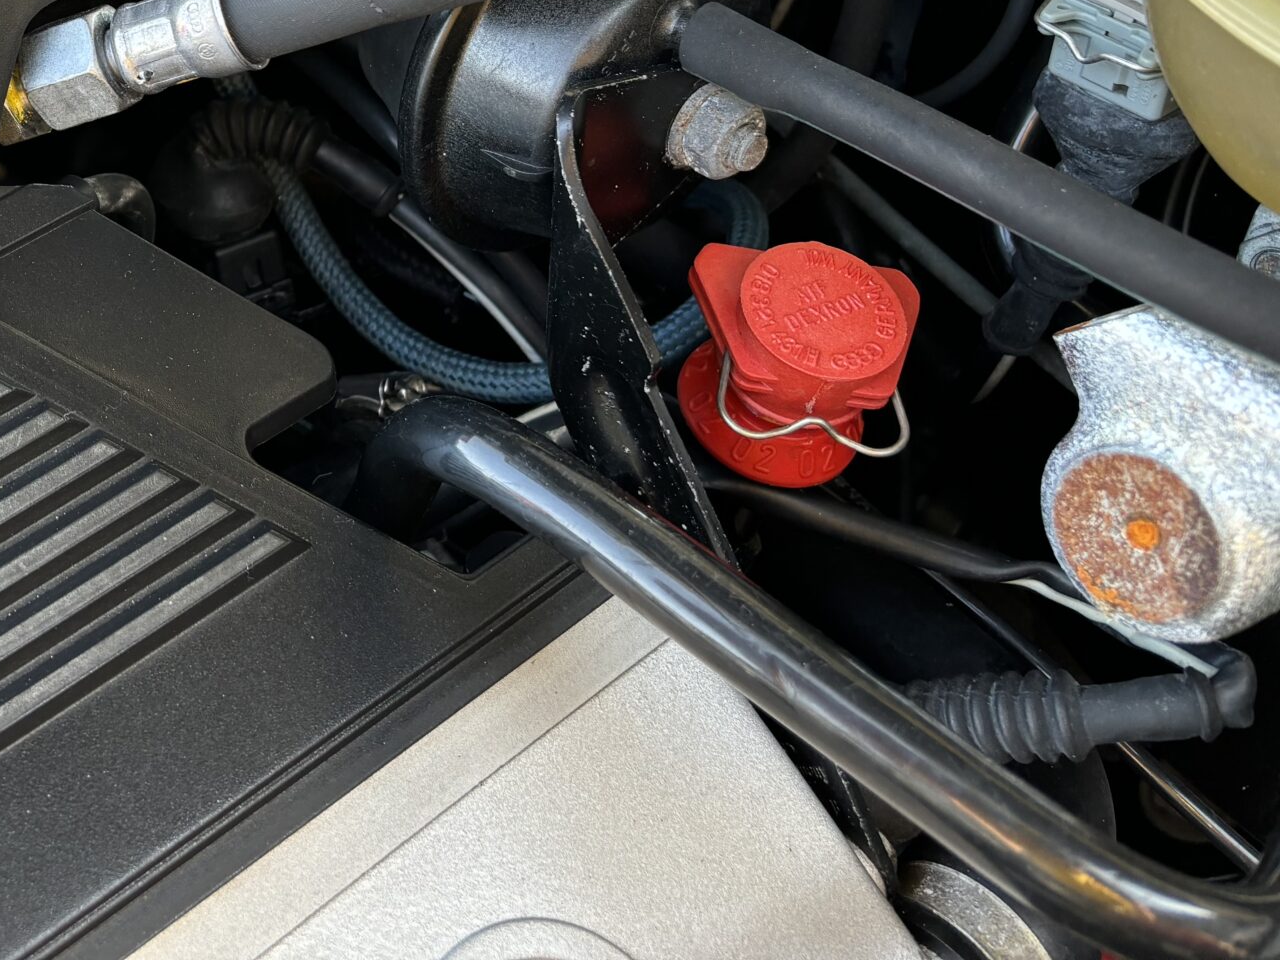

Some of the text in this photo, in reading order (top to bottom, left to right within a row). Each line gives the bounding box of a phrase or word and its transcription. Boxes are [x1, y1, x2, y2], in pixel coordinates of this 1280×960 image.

[784, 293, 866, 333] DEXRON
[839, 261, 897, 340] GERMANY
[731, 436, 777, 474] 02
[798, 446, 836, 478] 02
